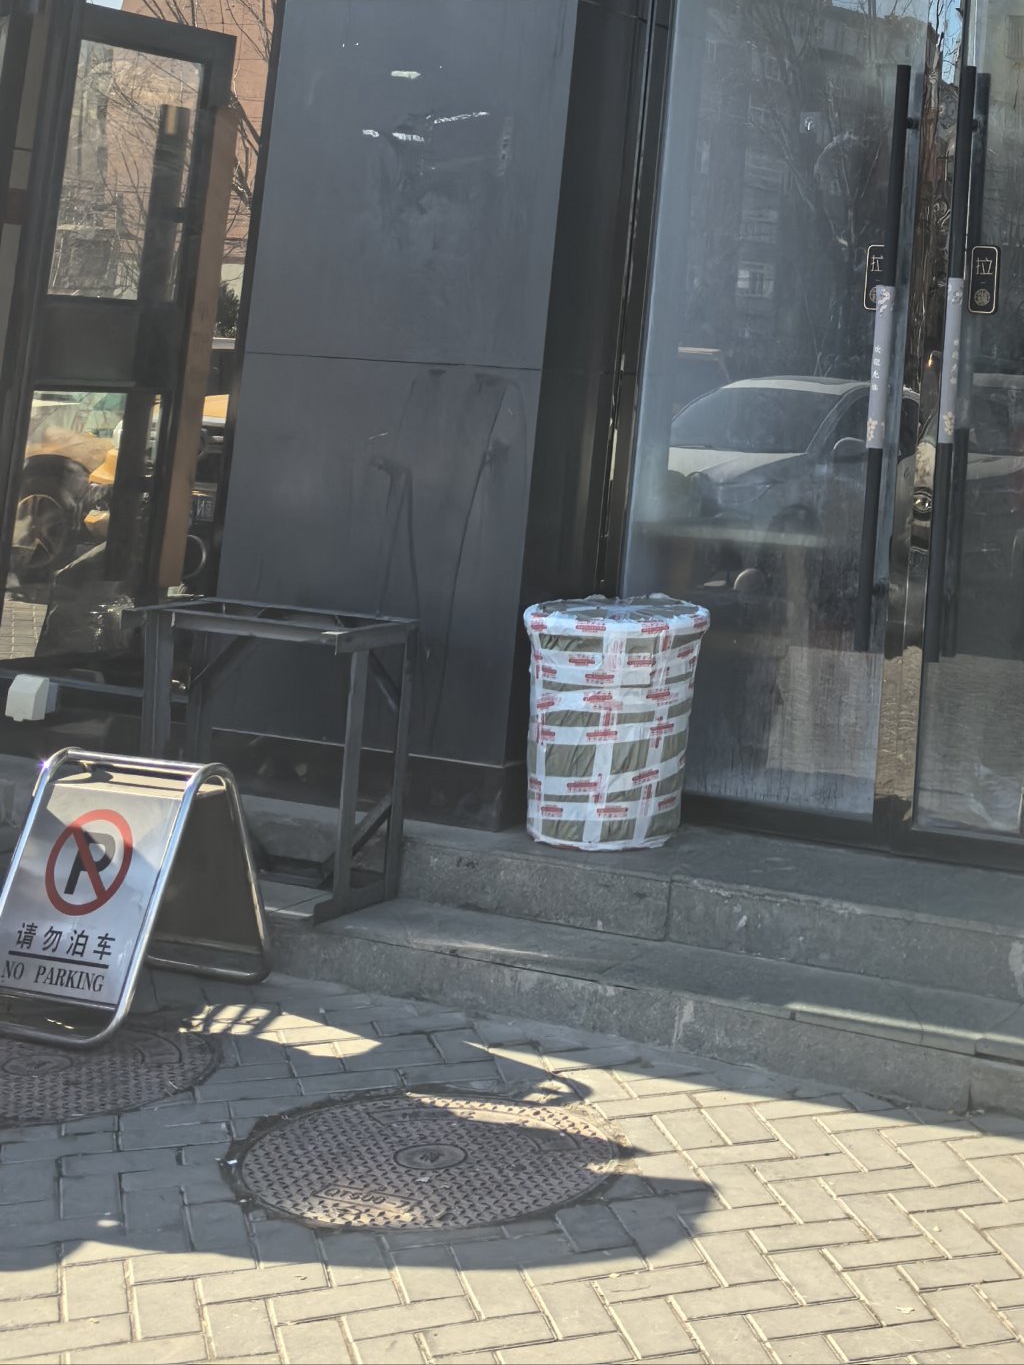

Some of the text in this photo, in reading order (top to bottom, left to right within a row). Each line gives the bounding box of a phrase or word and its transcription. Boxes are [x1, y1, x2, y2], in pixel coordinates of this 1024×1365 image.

[975, 257, 993, 275] 拉
[16, 922, 116, 960] 请勿泊车
[1, 960, 105, 993] NO PARKING
